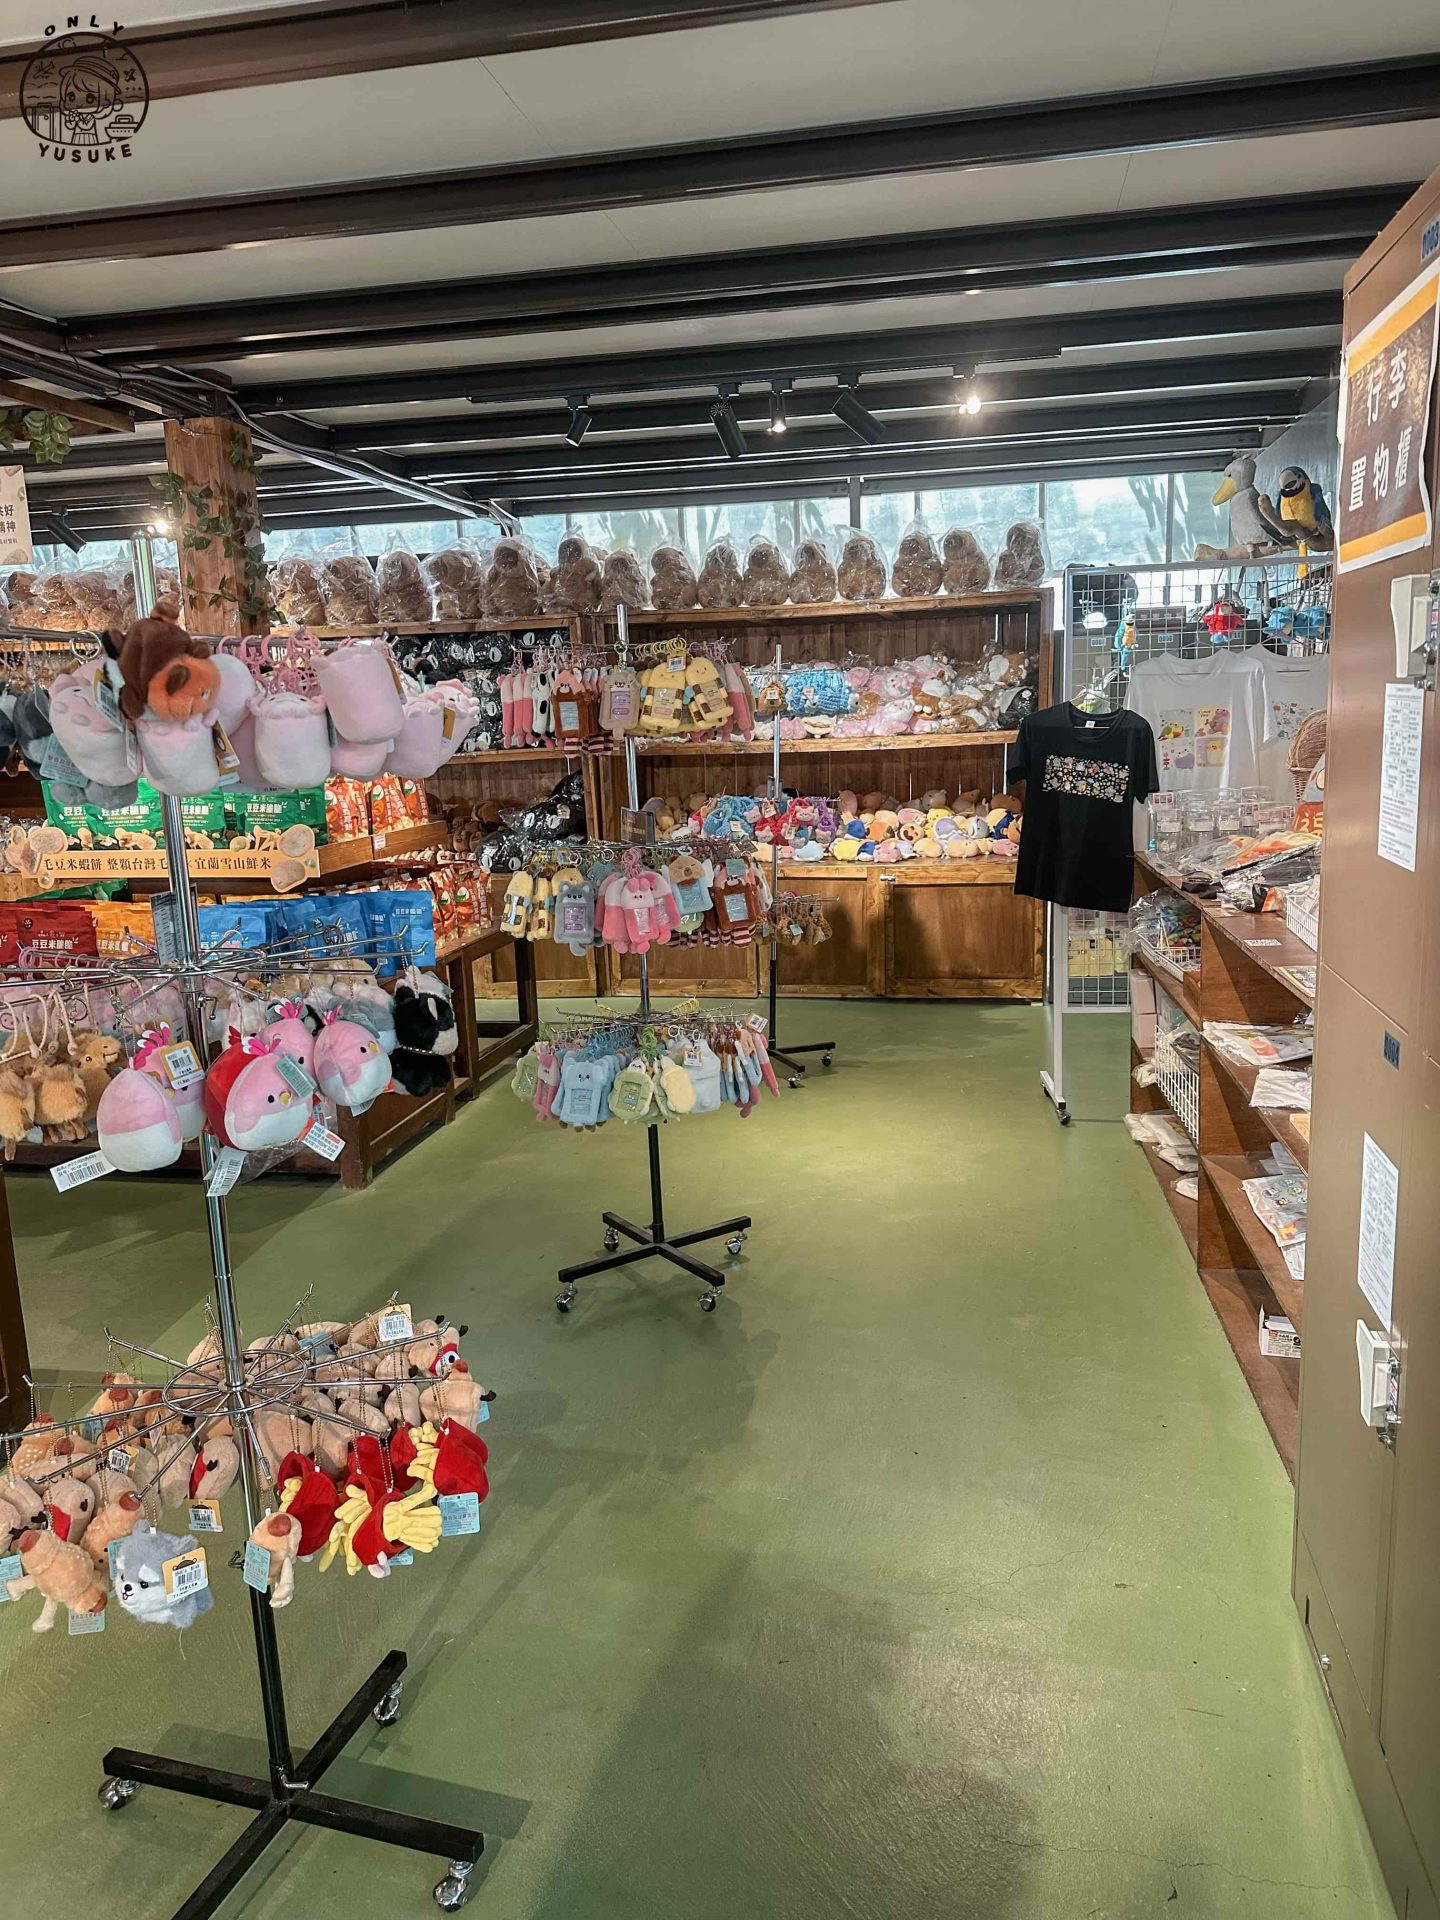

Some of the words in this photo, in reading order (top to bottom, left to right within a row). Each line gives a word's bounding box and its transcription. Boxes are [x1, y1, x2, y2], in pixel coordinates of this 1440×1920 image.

[1366, 347, 1408, 427] 行李
[1348, 425, 1413, 512] 置物櫃
